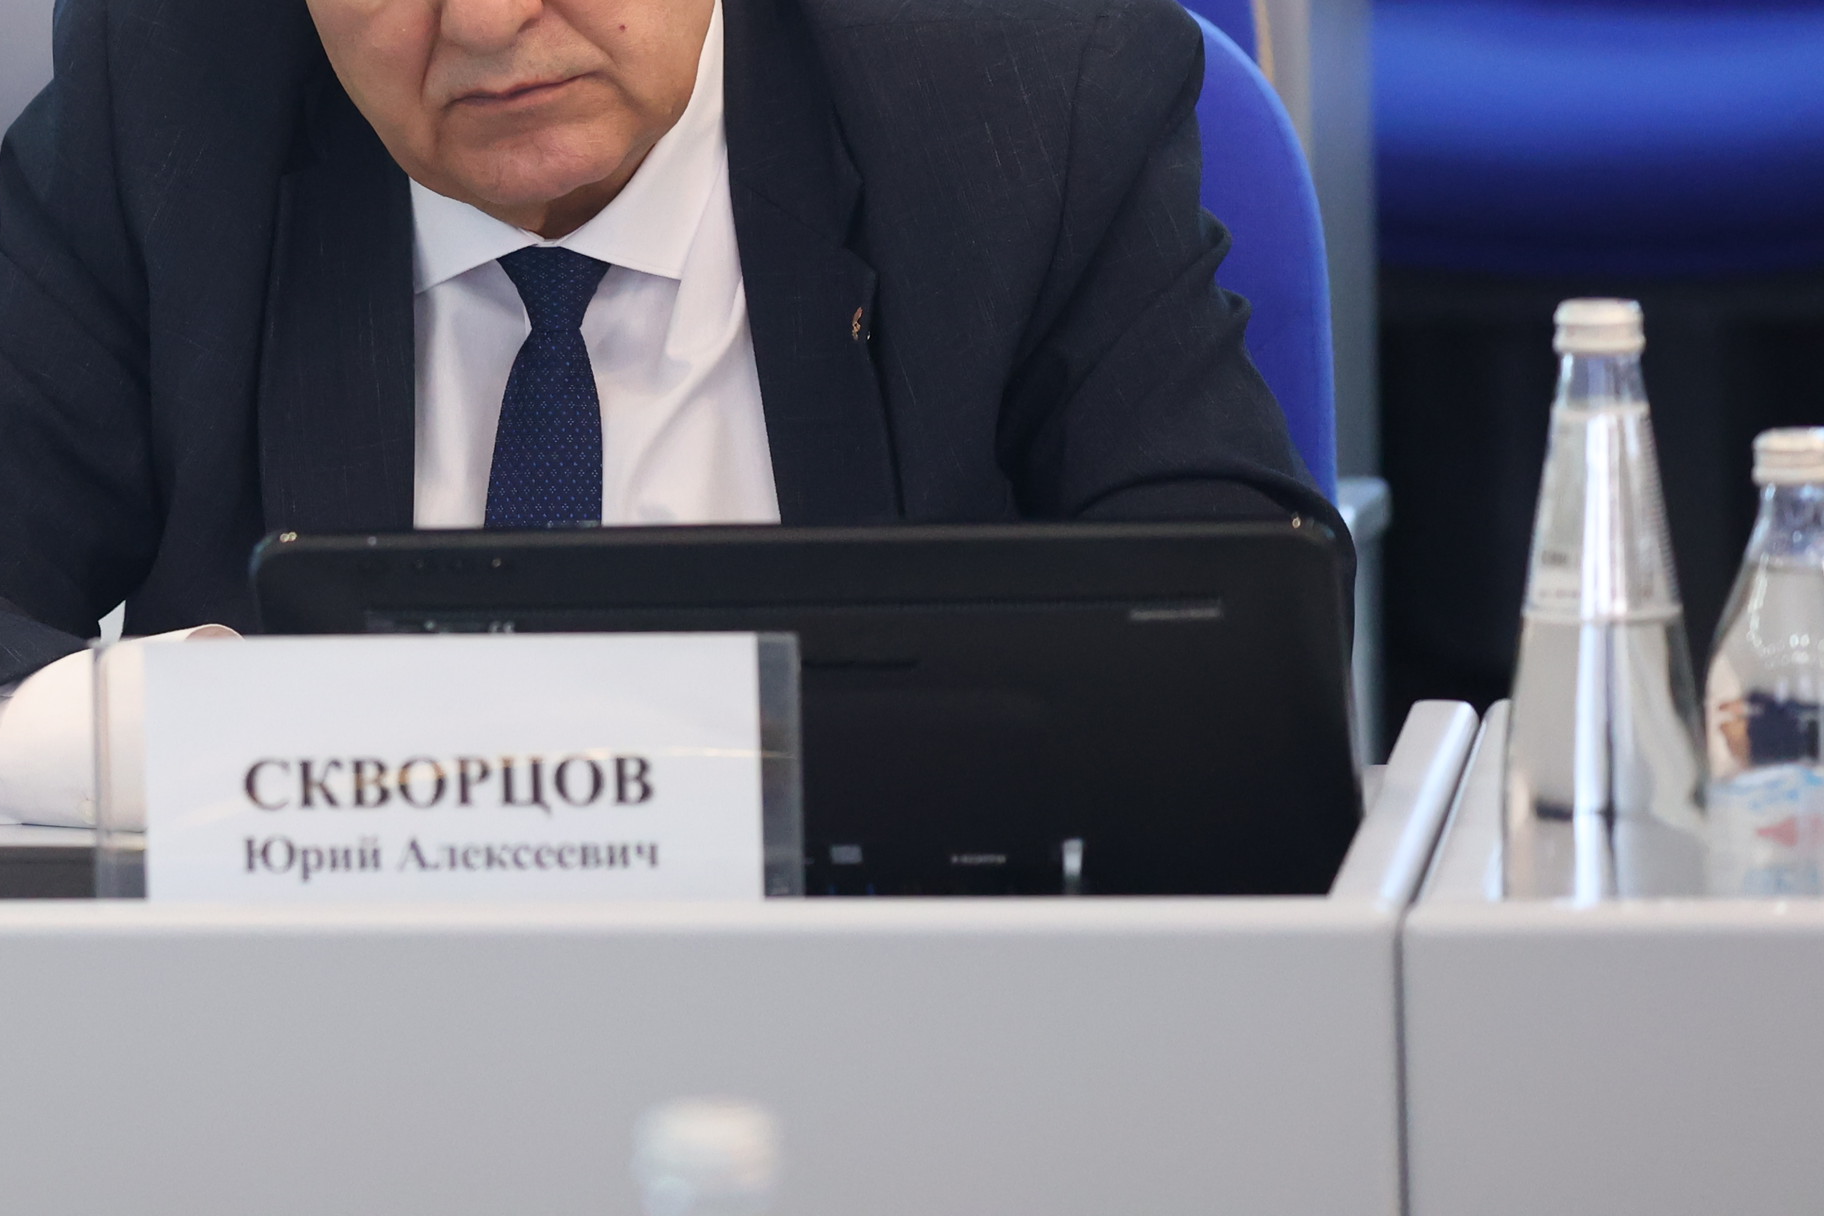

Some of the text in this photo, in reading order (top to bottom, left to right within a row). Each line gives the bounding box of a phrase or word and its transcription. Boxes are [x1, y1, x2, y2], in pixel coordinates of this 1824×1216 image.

[244, 755, 655, 817] СКВОРЦОВ
[245, 835, 659, 882] Юрий Алексеевич
